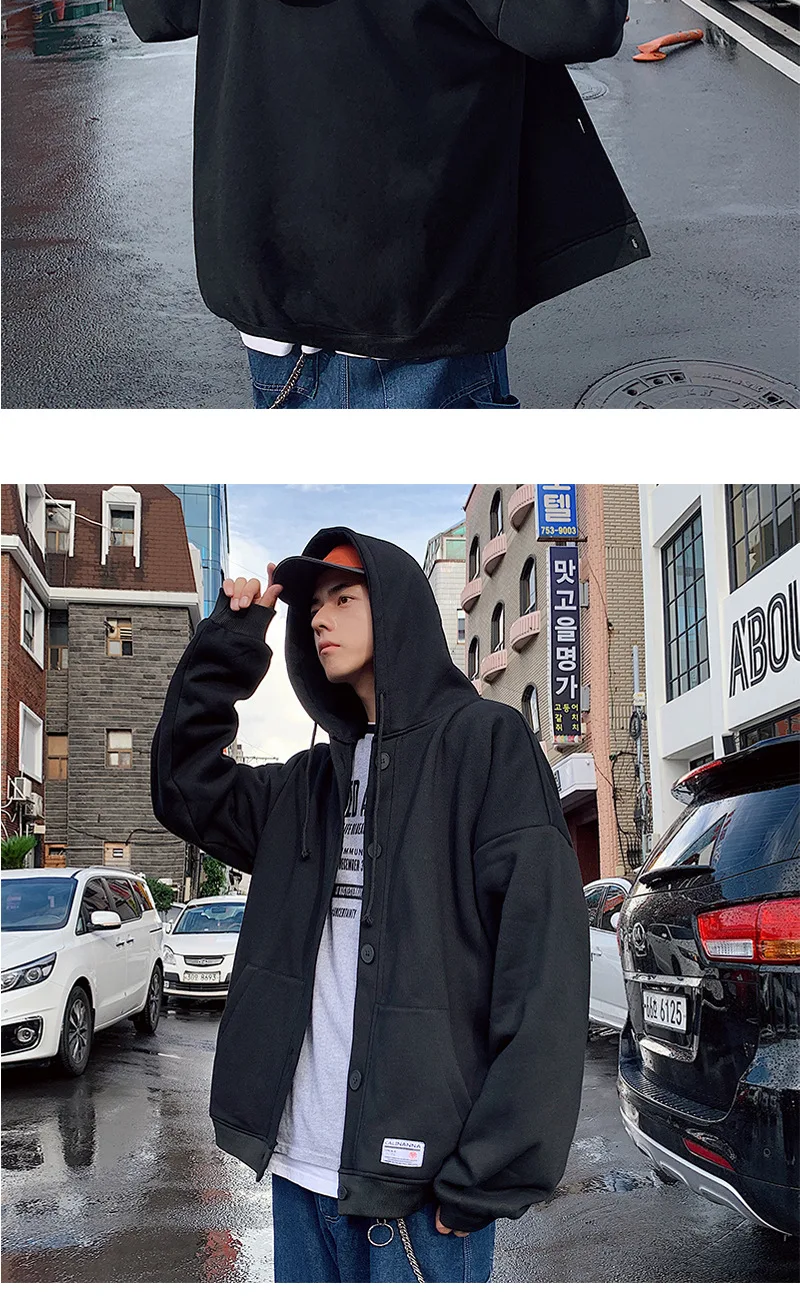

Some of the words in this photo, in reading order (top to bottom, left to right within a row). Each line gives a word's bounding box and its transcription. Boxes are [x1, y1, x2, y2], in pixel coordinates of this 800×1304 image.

[540, 526, 577, 535] 753-9003
[554, 559, 579, 699] 맛고을명가
[554, 703, 579, 713] 고등어
[660, 998, 683, 1025] 6125
